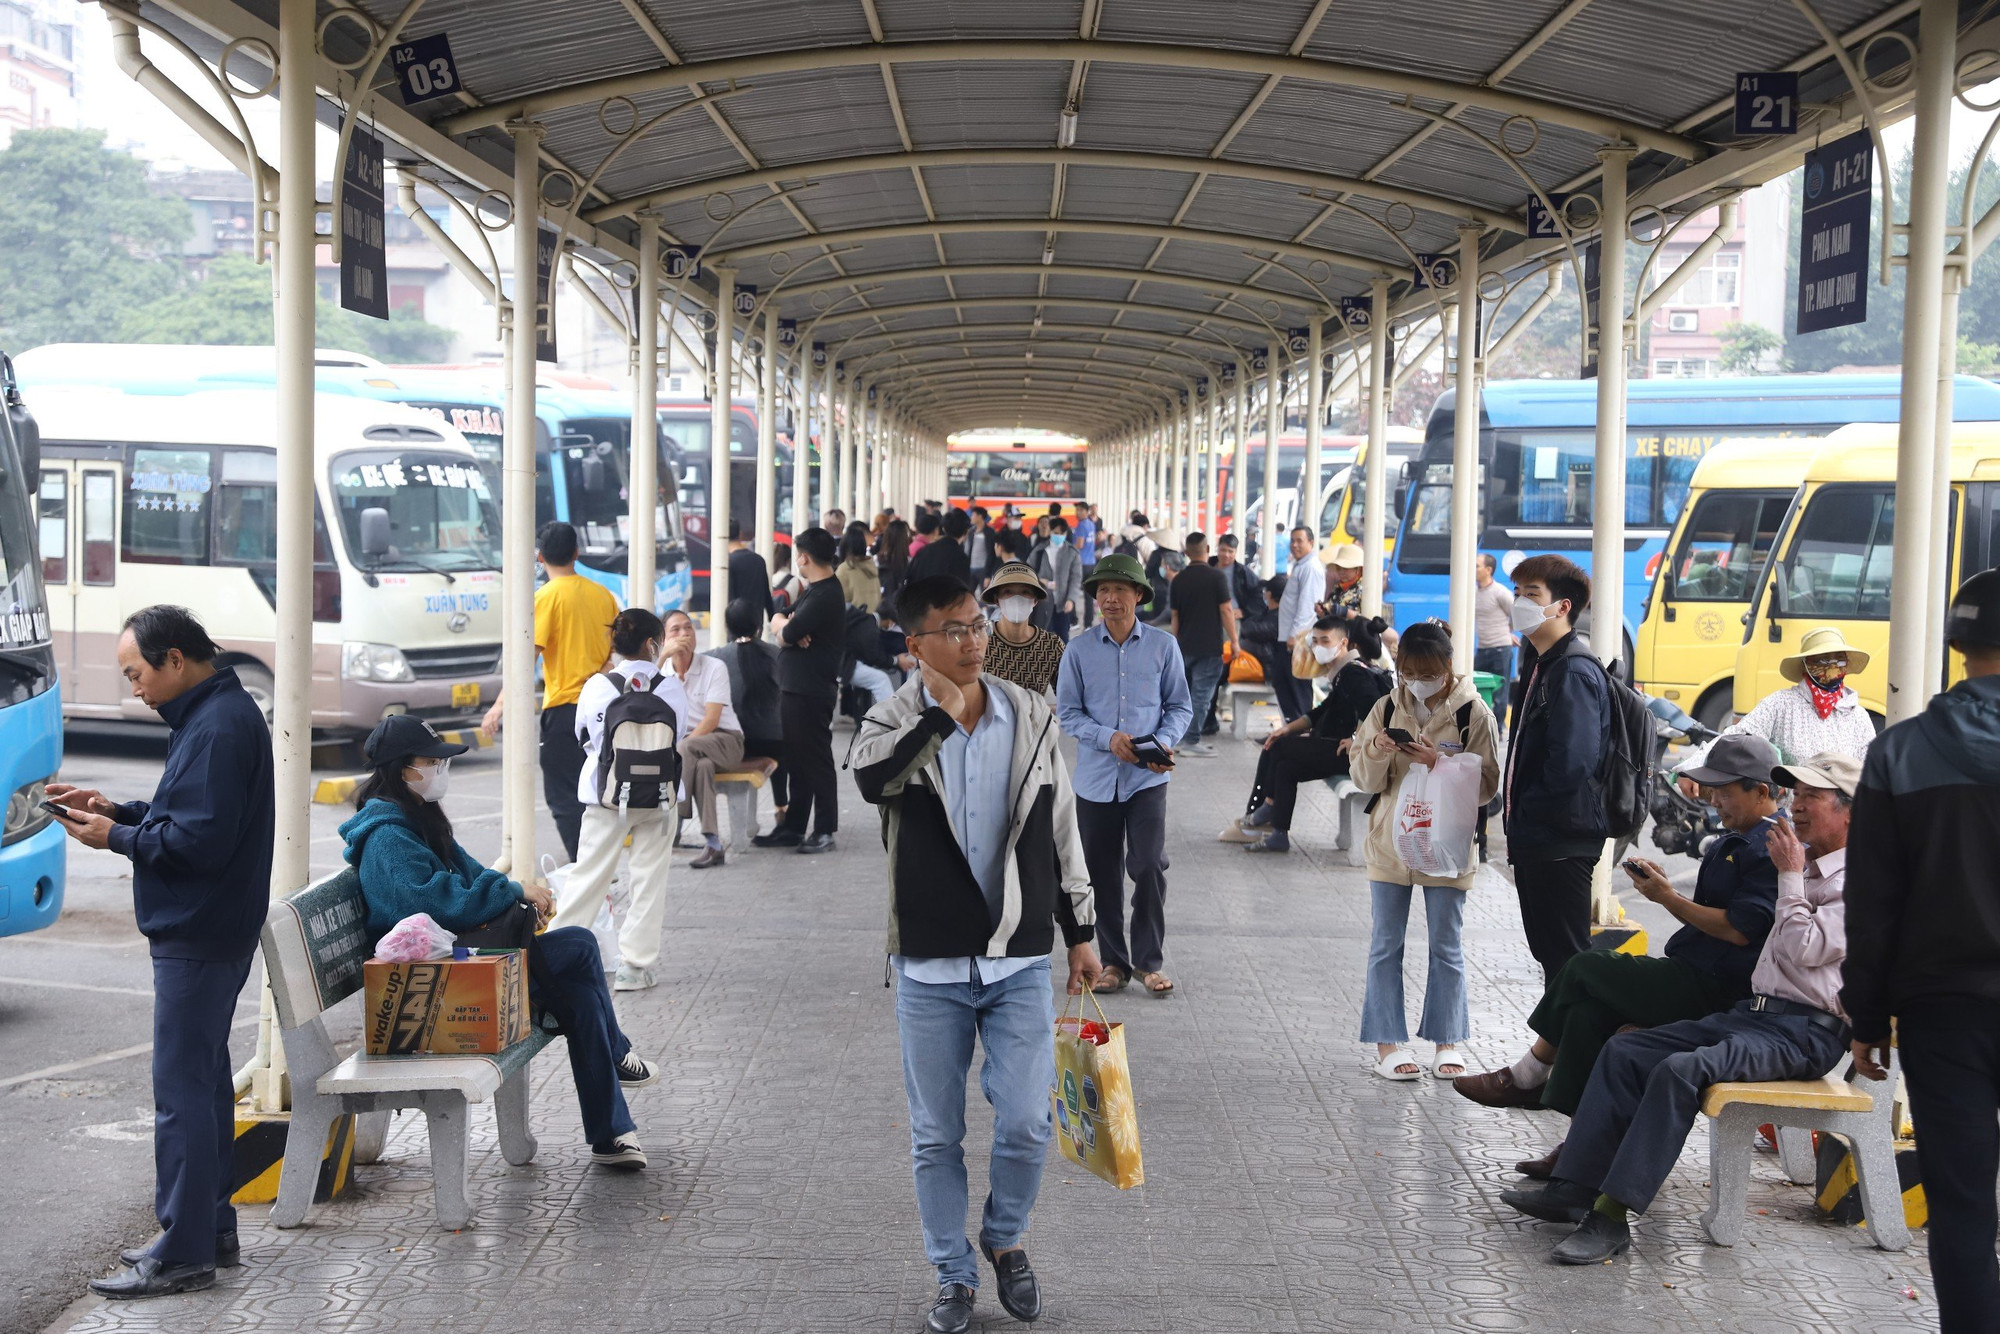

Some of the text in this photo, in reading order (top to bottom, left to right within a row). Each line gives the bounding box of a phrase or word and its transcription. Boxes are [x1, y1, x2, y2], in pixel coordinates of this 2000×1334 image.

[396, 47, 415, 64] A2
[408, 58, 453, 95] 03
[1740, 77, 1758, 91] A1
[1751, 96, 1790, 127] 21
[1832, 150, 1867, 192] A1-21
[1812, 222, 1851, 263] PHÍA NAM
[1805, 272, 1858, 313] TP. NAM ĐỊNH
[1634, 437, 1660, 457] XE
[425, 588, 488, 613] XUÂN TÙNG
[0, 615, 10, 643] X
[8, 606, 33, 643] GIÁP
[308, 907, 329, 940] NHÀ
[324, 908, 339, 934] XE
[335, 897, 357, 928] TÙNG
[371, 971, 404, 1045] wake-up
[398, 964, 436, 1050] 247
[499, 966, 510, 1042] wake-up
